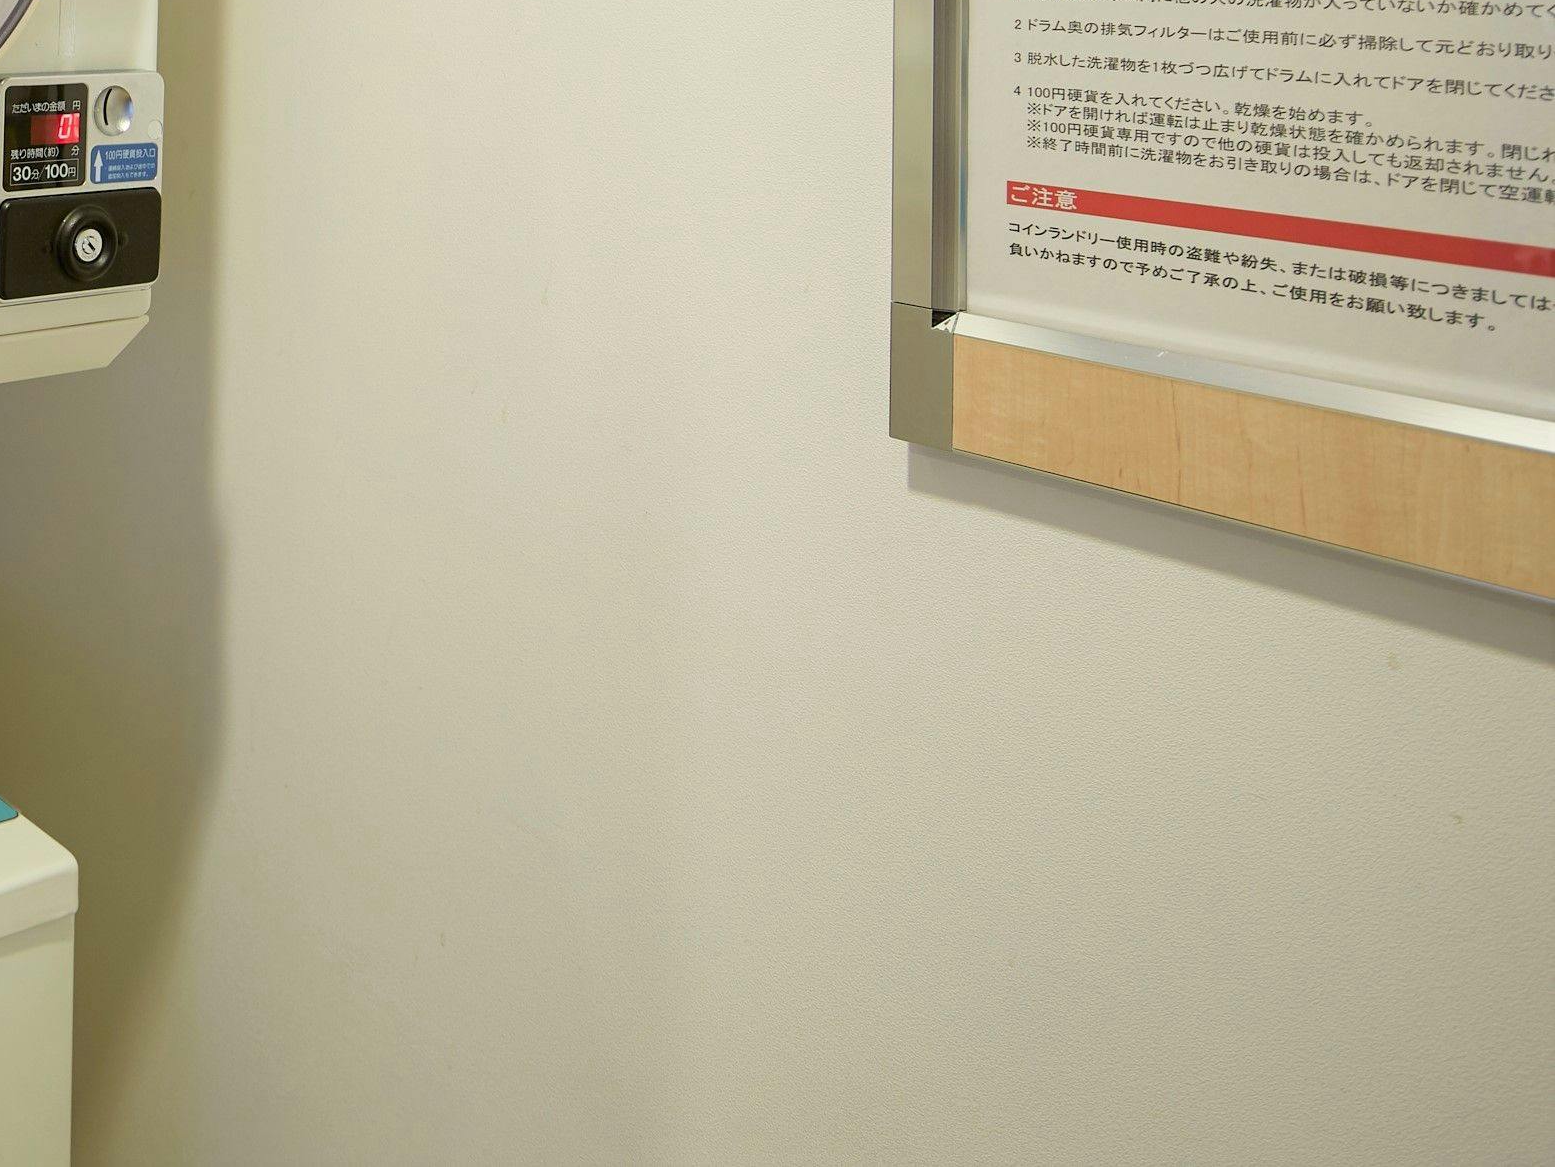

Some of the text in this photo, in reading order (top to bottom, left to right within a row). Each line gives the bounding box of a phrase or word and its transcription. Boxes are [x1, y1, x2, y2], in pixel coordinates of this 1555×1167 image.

[1015, 19, 1555, 60] 2 ドラム奥の排気フィルターはご使用前に必ず掃除して元どおり取り
[1015, 53, 1022, 63] 3
[12, 101, 80, 113] ただいまの金額 円
[1014, 86, 1375, 127] 4 100円硬貨を入れてください。乾燥を始めます。
[71, 146, 79, 156] 分
[1009, 186, 1078, 209] ご注意
[1009, 221, 1555, 312] コインランドリー使用時の盗難や紛失、または破損等につきましては
[1010, 243, 1498, 331] 負いかねますので予めご了承の上、ご使用をお願い致します。
